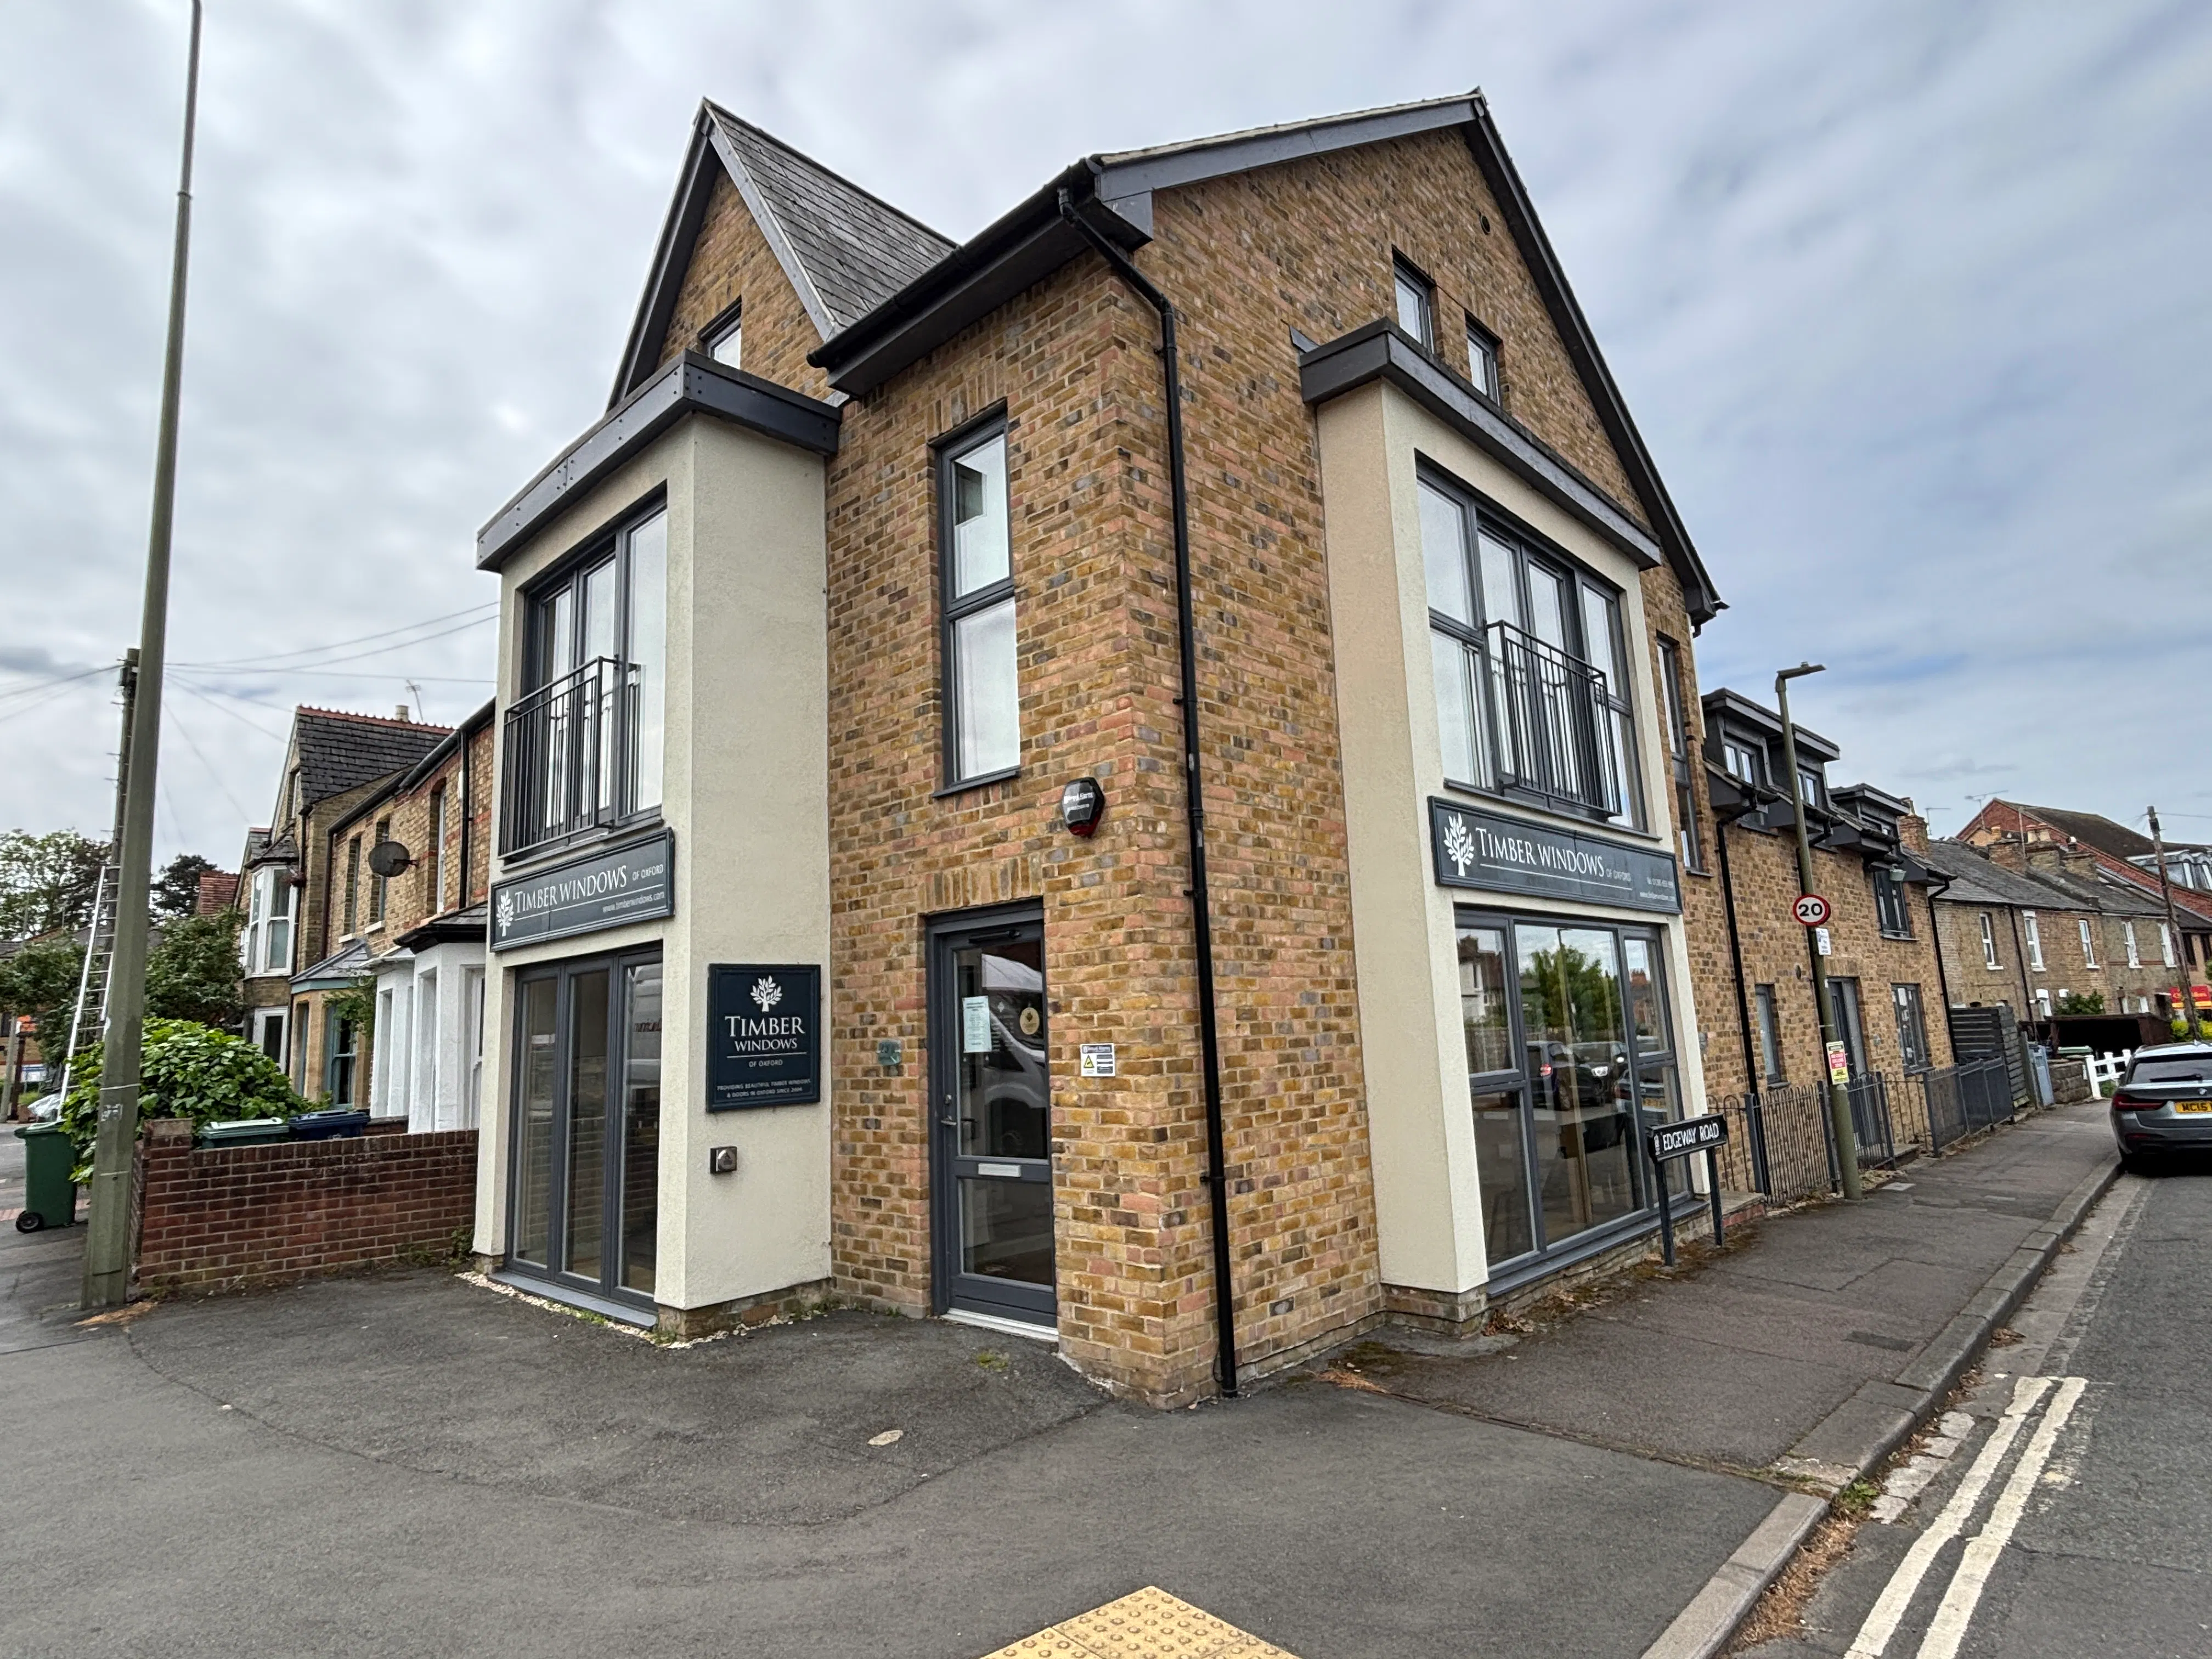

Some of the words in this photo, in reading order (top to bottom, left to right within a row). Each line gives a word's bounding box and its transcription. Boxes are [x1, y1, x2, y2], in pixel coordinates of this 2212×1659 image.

[1475, 827, 1537, 865] TIMBER
[1537, 843, 1604, 877] WINDOWS
[515, 885, 557, 913] TIMBER
[559, 865, 627, 902] WINDOWS
[632, 870, 640, 881] OF
[641, 864, 664, 879] OXFORD
[1798, 903, 1822, 916] 20
[724, 1016, 805, 1037] TIMBER
[734, 1037, 798, 1052] WINDOWS
[1662, 1127, 1696, 1151] EDGEWAY
[1699, 1122, 1719, 1141] ROAD
